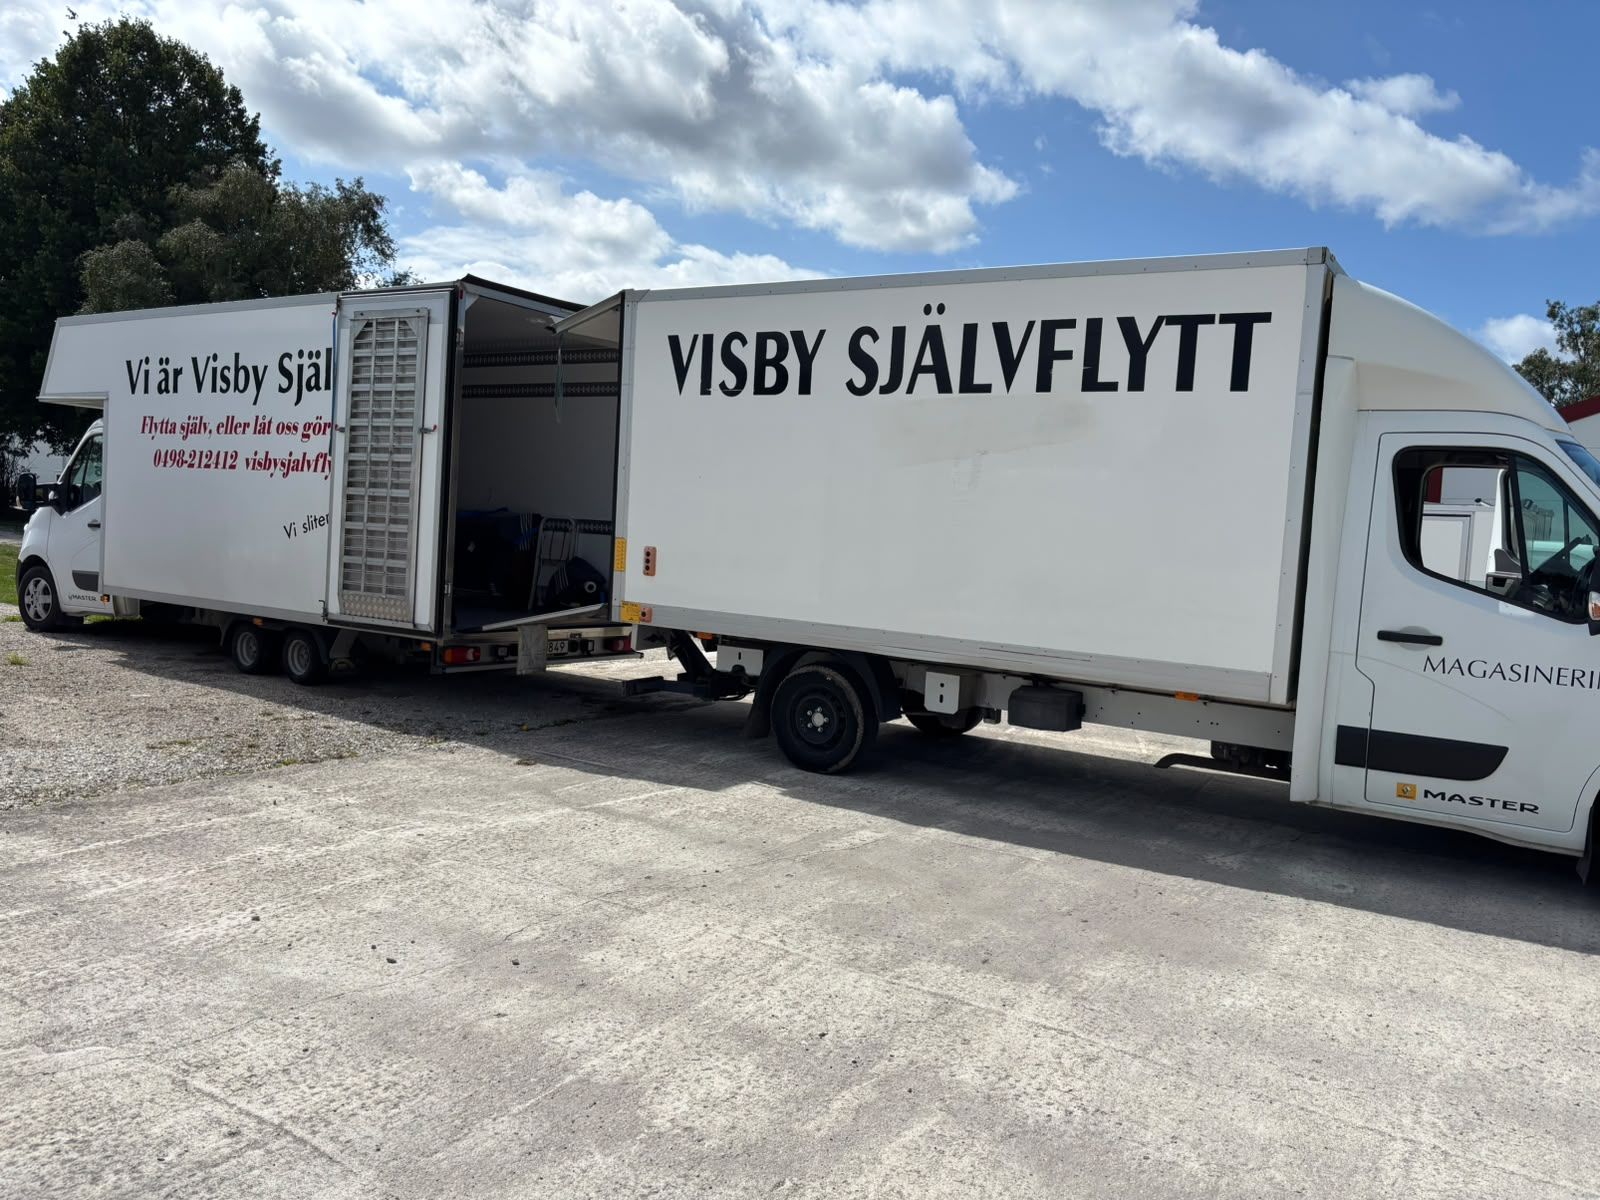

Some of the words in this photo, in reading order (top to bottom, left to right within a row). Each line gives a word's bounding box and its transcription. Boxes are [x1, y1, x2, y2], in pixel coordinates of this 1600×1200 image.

[667, 328, 827, 397] VISBY
[845, 302, 1273, 398] SJÄLVFLYTT
[125, 356, 150, 395] Vi
[156, 356, 183, 395] är
[191, 352, 268, 405] Visby
[140, 415, 177, 441] Flytta
[179, 416, 213, 441] själv,
[216, 416, 250, 436] eller
[252, 414, 273, 436] låt
[275, 421, 299, 436] oss
[153, 449, 238, 470] 0498-212412
[283, 522, 298, 540] Vi
[1423, 655, 1600, 690] MAGASINERI
[1423, 789, 1539, 814] MASTER
